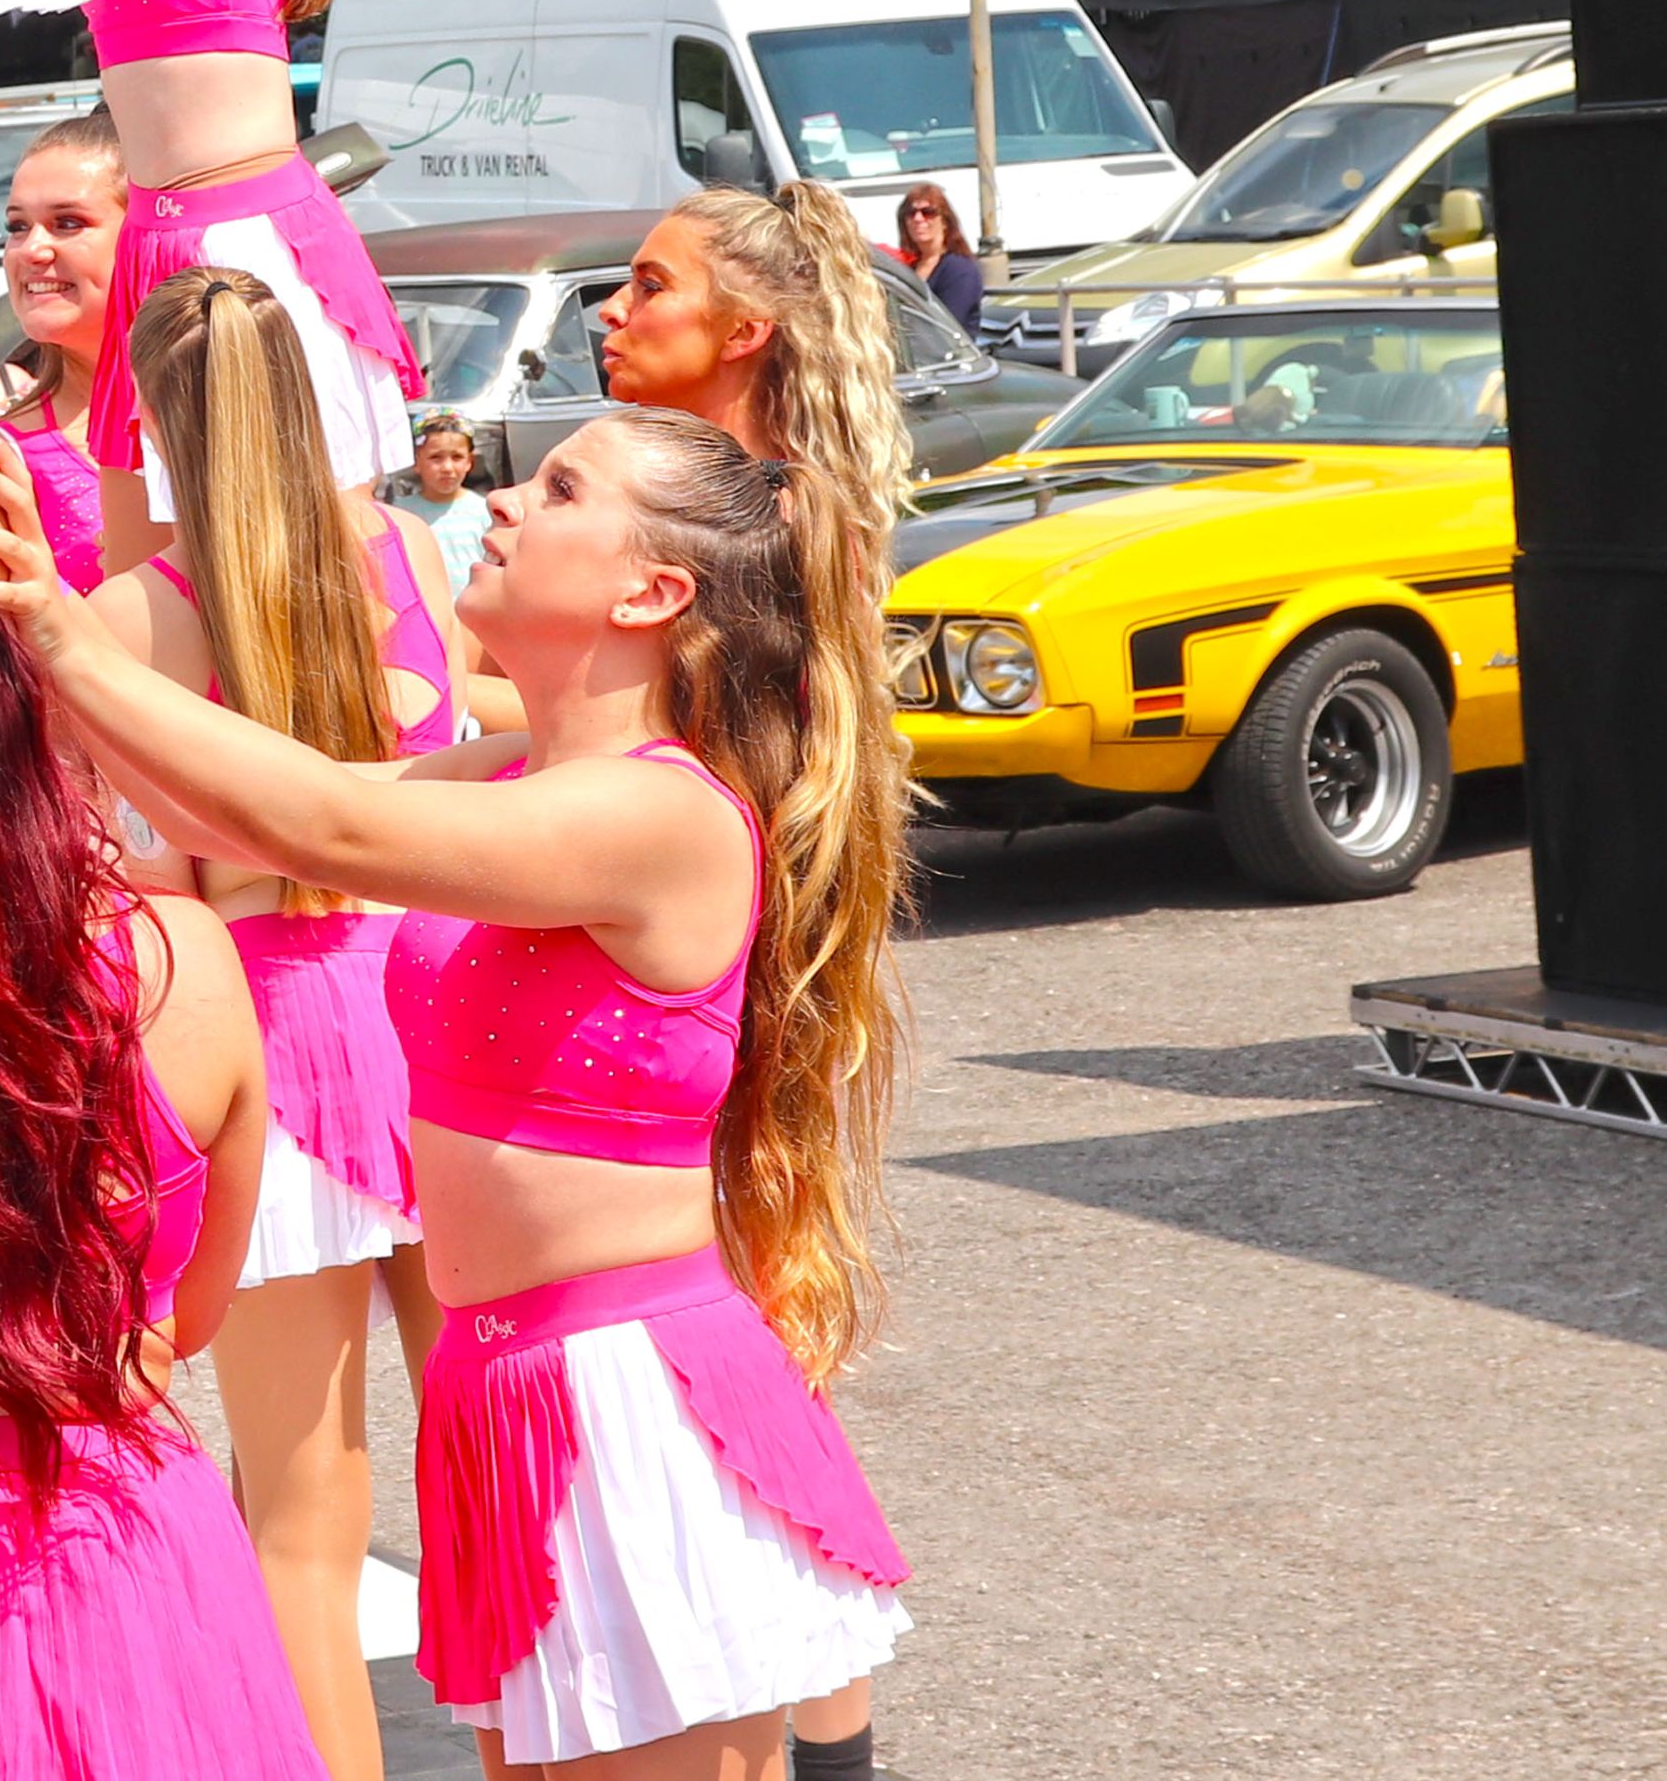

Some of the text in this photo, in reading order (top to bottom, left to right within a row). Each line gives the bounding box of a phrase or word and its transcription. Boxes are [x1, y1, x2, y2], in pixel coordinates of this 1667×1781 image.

[388, 49, 576, 150] Driveline
[421, 154, 550, 177] TRUCK & VAN RENTAL
